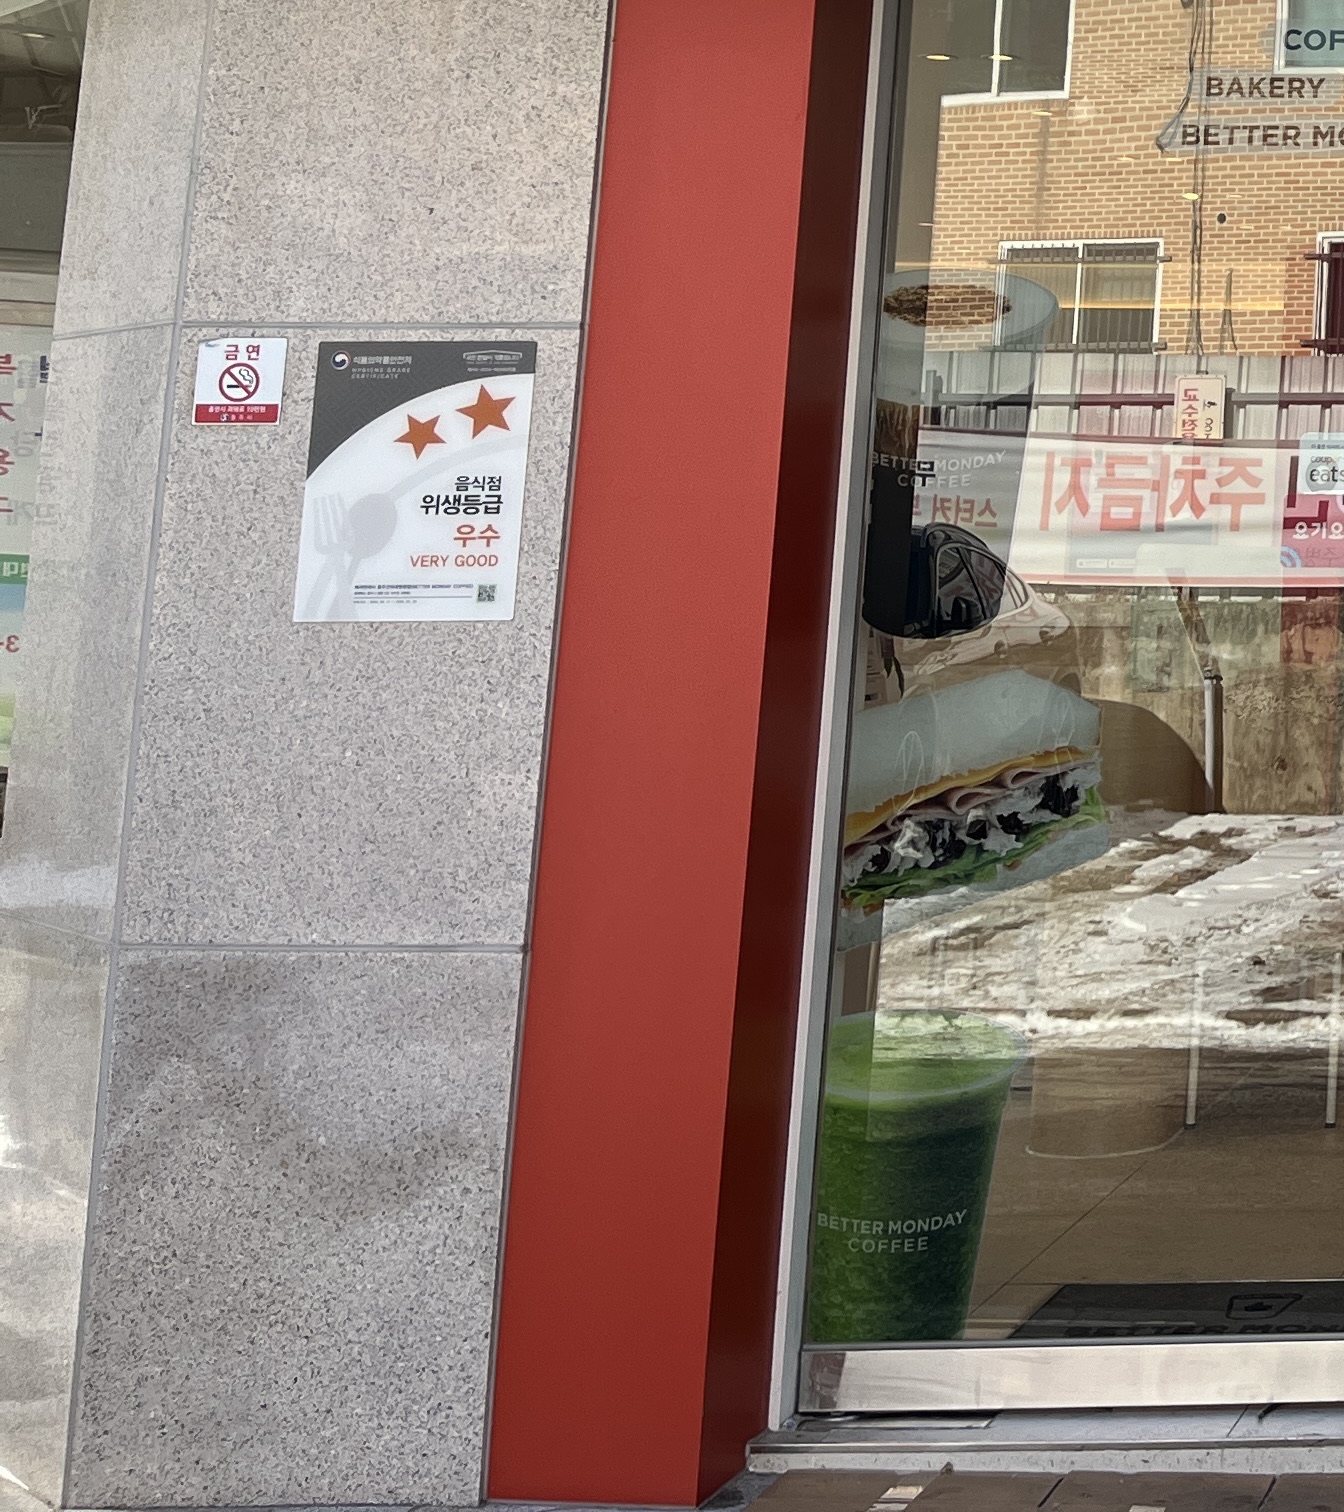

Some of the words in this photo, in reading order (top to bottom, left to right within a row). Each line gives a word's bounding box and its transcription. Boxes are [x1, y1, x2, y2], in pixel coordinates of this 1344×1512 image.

[1206, 76, 1326, 99] BAKERY
[1182, 124, 1300, 147] BETTER
[224, 344, 260, 361] 금연
[935, 450, 1006, 472] MONDAY
[454, 475, 502, 492] 음식점
[897, 473, 971, 488] COFFEE
[420, 494, 503, 515] 위생등급
[453, 524, 500, 548] 우수
[1292, 522, 1344, 539] 요기요
[410, 554, 448, 567] VERY
[454, 554, 499, 567] GOOD
[817, 1212, 884, 1236] BETTER
[888, 1209, 967, 1235] MONDAY
[848, 1236, 929, 1254] COFFEE
